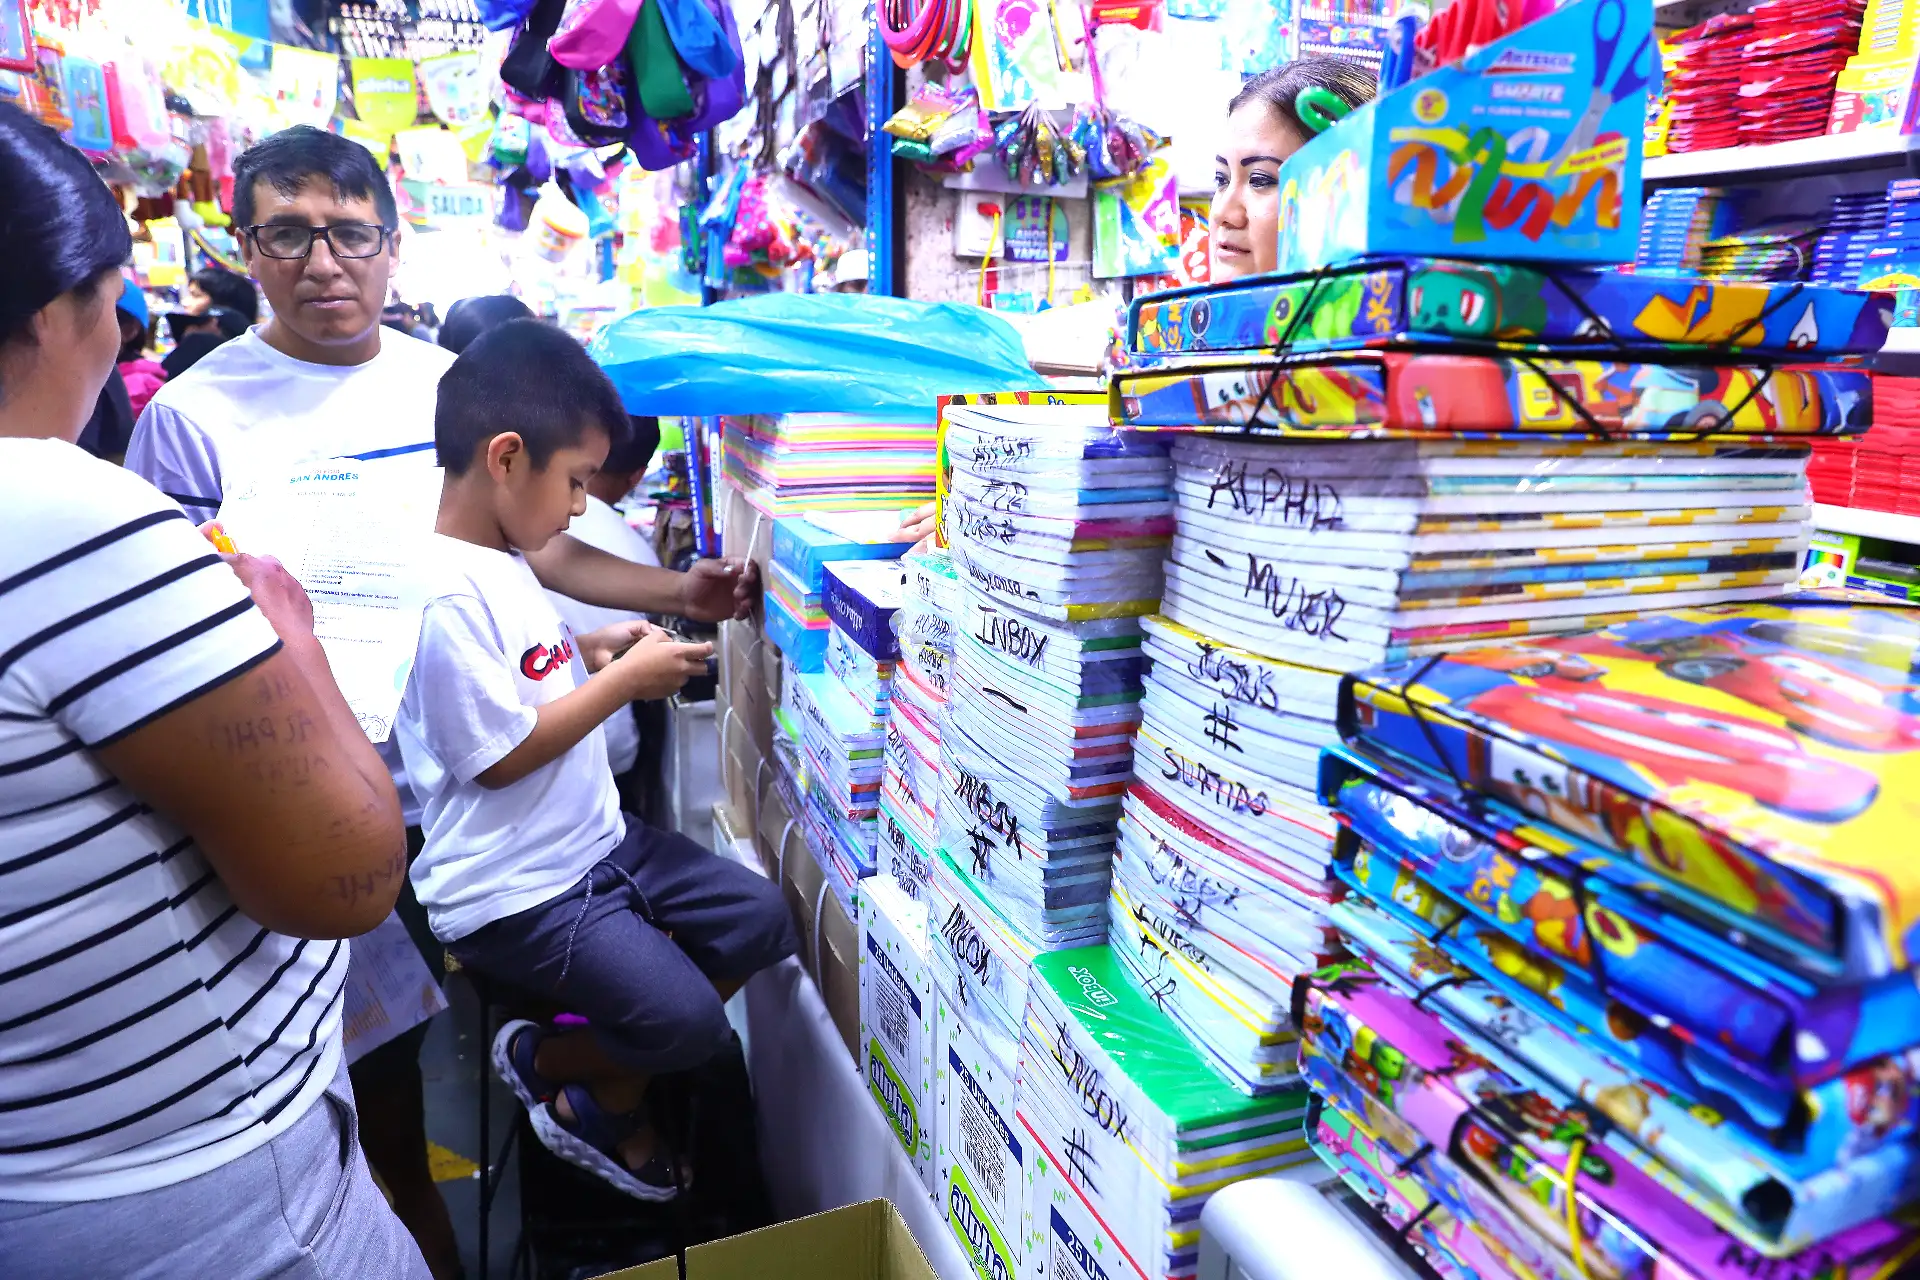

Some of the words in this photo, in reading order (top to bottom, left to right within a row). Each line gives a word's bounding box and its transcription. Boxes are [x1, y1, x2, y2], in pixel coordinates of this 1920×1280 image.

[431, 194, 485, 216] SALIDA
[290, 475, 310, 484] SAN
[314, 472, 359, 481] ANDRES
[975, 604, 1048, 669] INBOX
[1162, 747, 1269, 817] SURTIDO
[874, 944, 883, 963] 25
[883, 955, 912, 1004] Unidades
[871, 1054, 913, 1147] alpha
[959, 1063, 970, 1082] 25
[971, 1081, 1011, 1145] Unidades
[1050, 1022, 1128, 1144] INBOX
[1067, 1230, 1083, 1262] 25
